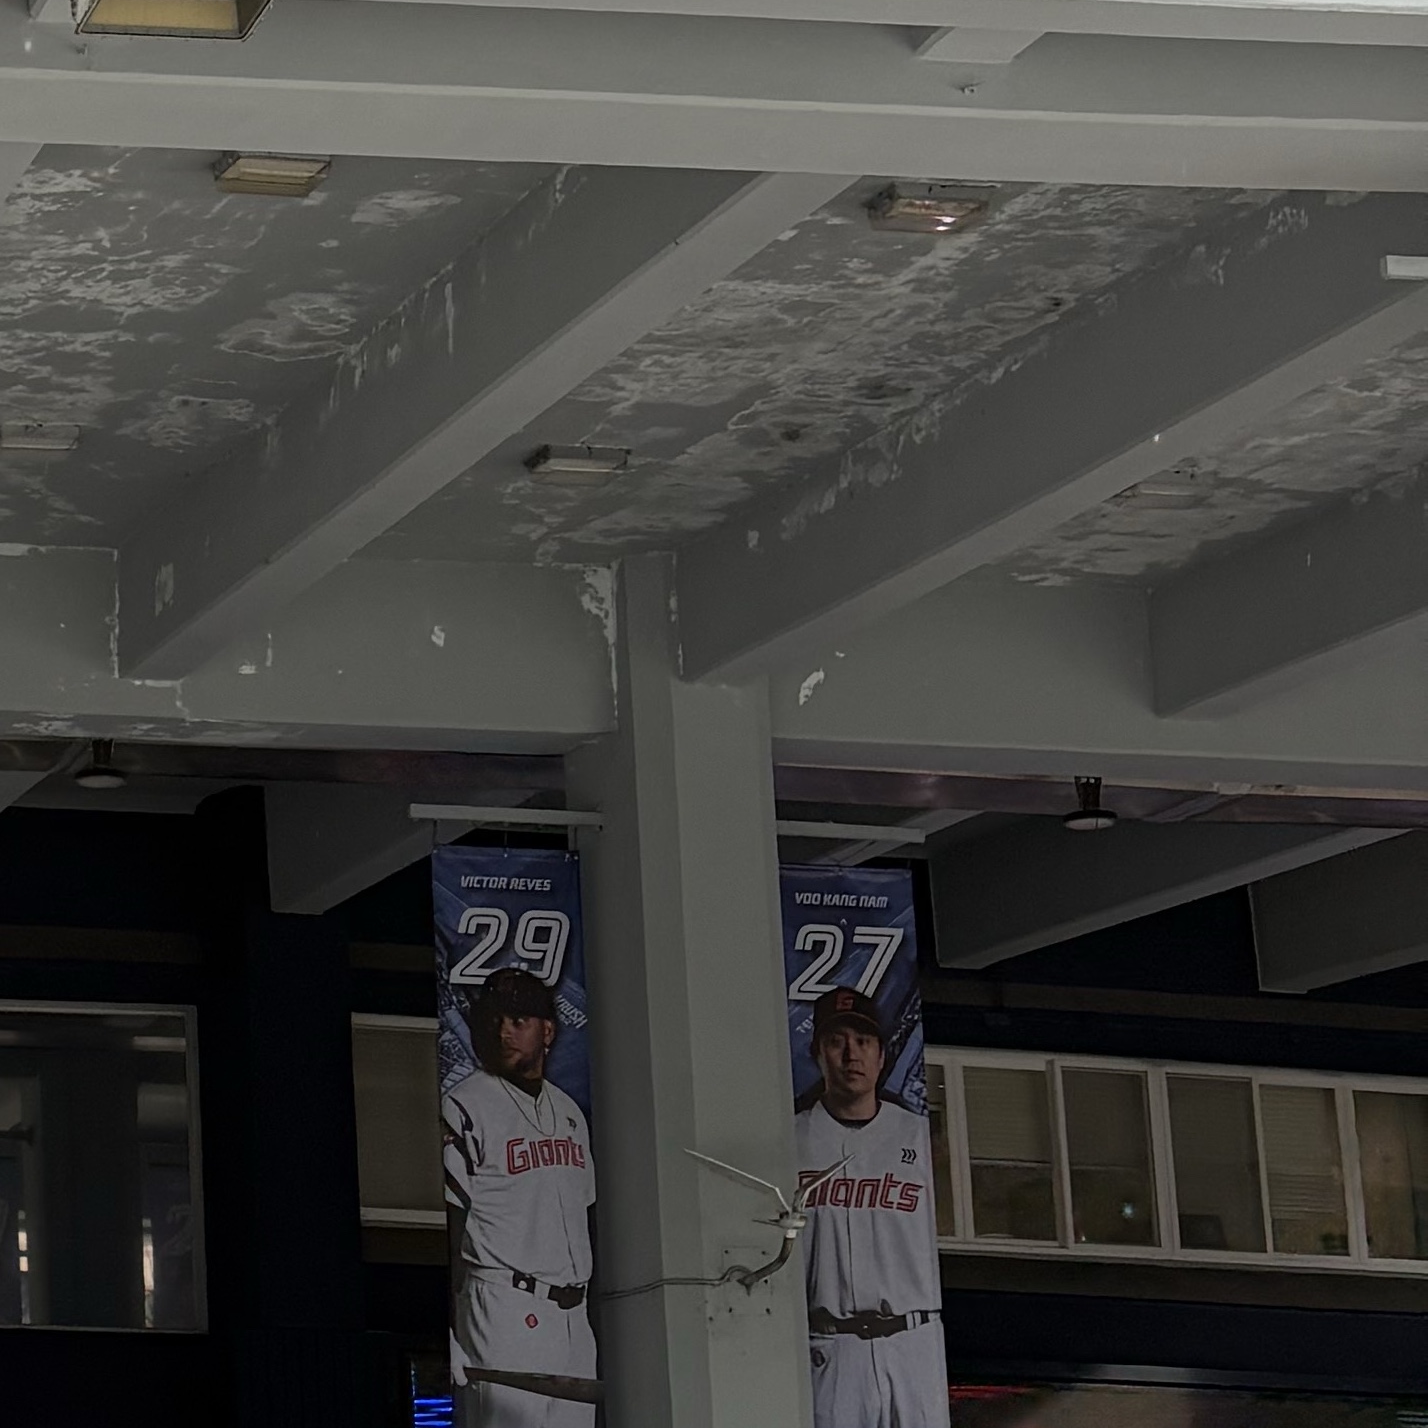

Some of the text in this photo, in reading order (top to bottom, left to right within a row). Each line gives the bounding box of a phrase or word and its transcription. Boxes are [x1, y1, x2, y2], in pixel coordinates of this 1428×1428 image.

[460, 875, 508, 890] VICTOR
[822, 892, 858, 908] KANG
[858, 894, 889, 910] NAM
[449, 906, 571, 988] 29
[788, 923, 905, 1002] 27
